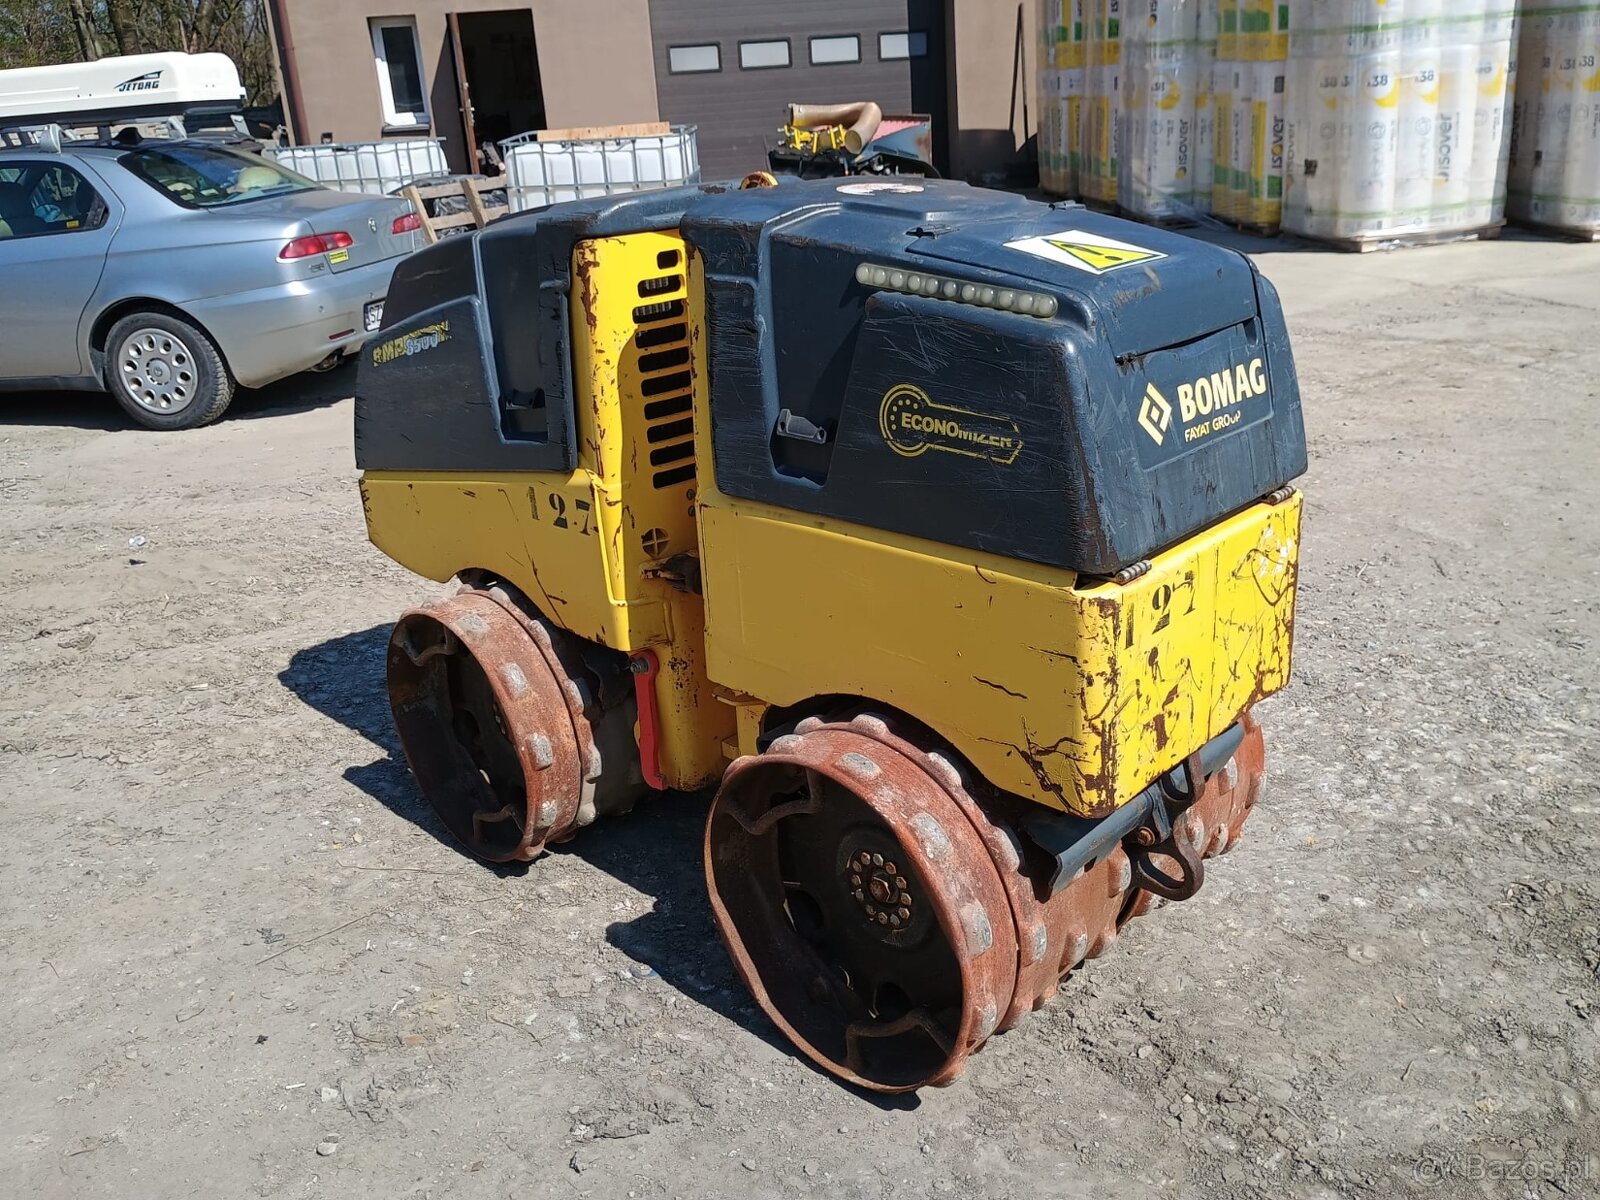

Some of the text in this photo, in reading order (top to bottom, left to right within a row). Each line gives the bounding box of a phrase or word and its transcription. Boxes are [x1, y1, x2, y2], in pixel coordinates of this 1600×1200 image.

[1177, 358, 1267, 423] BOMAG
[1184, 410, 1241, 443] FAYAT GROUP
[526, 486, 591, 537] 127
[1124, 569, 1196, 650] 127
